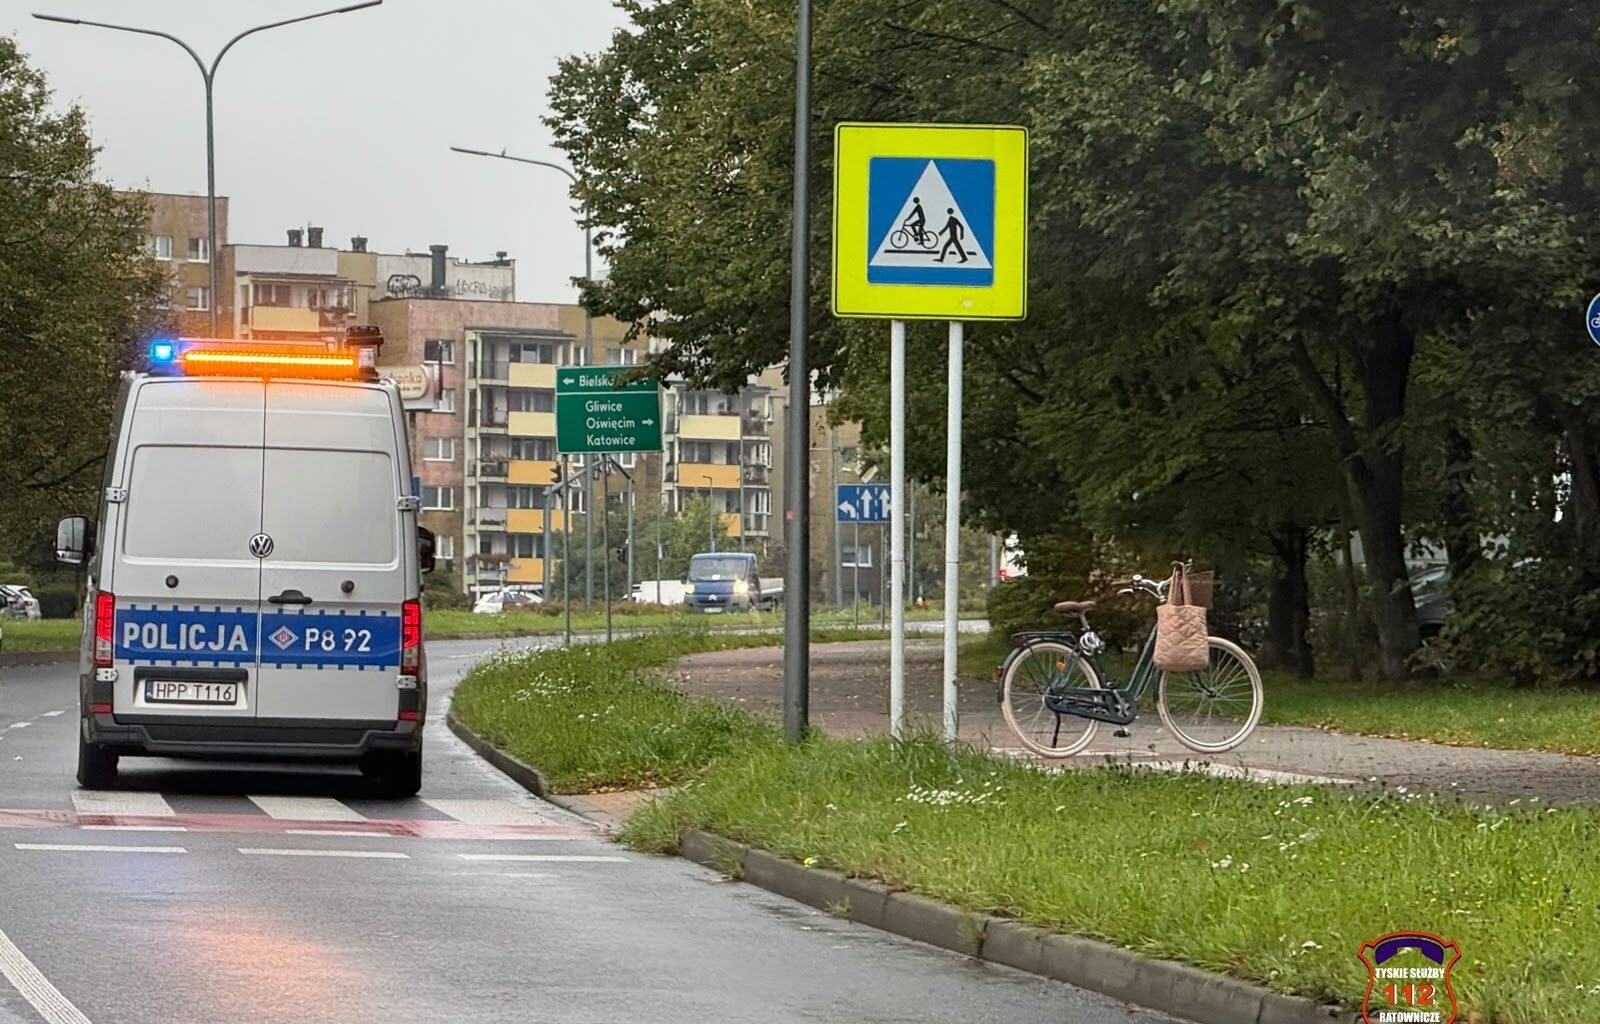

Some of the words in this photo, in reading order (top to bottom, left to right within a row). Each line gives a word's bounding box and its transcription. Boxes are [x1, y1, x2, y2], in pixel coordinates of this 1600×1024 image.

[585, 400, 622, 412] Gliwice
[586, 416, 635, 430] Oświęcim
[586, 434, 636, 446] Katowice
[123, 622, 248, 651] POLICJA
[156, 683, 187, 699] HPP
[194, 685, 232, 701] T116
